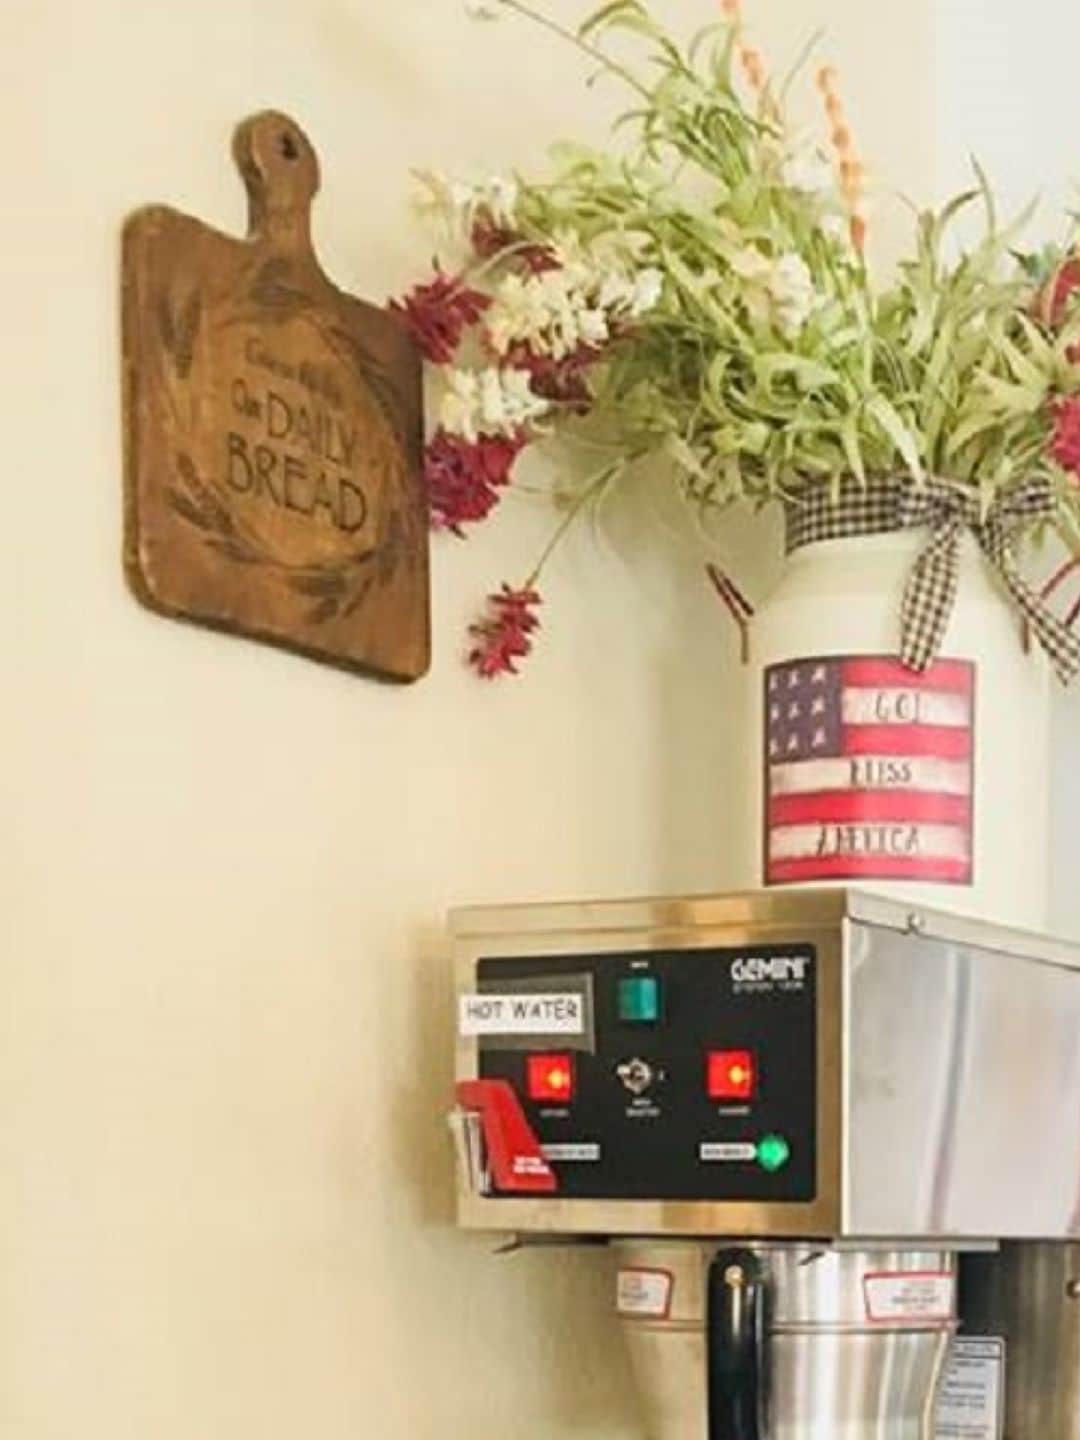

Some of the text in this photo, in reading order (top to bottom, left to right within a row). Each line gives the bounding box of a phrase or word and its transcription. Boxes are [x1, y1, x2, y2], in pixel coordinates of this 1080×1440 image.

[226, 430, 368, 536] BREAD
[466, 997, 578, 1021] HOT WATER
